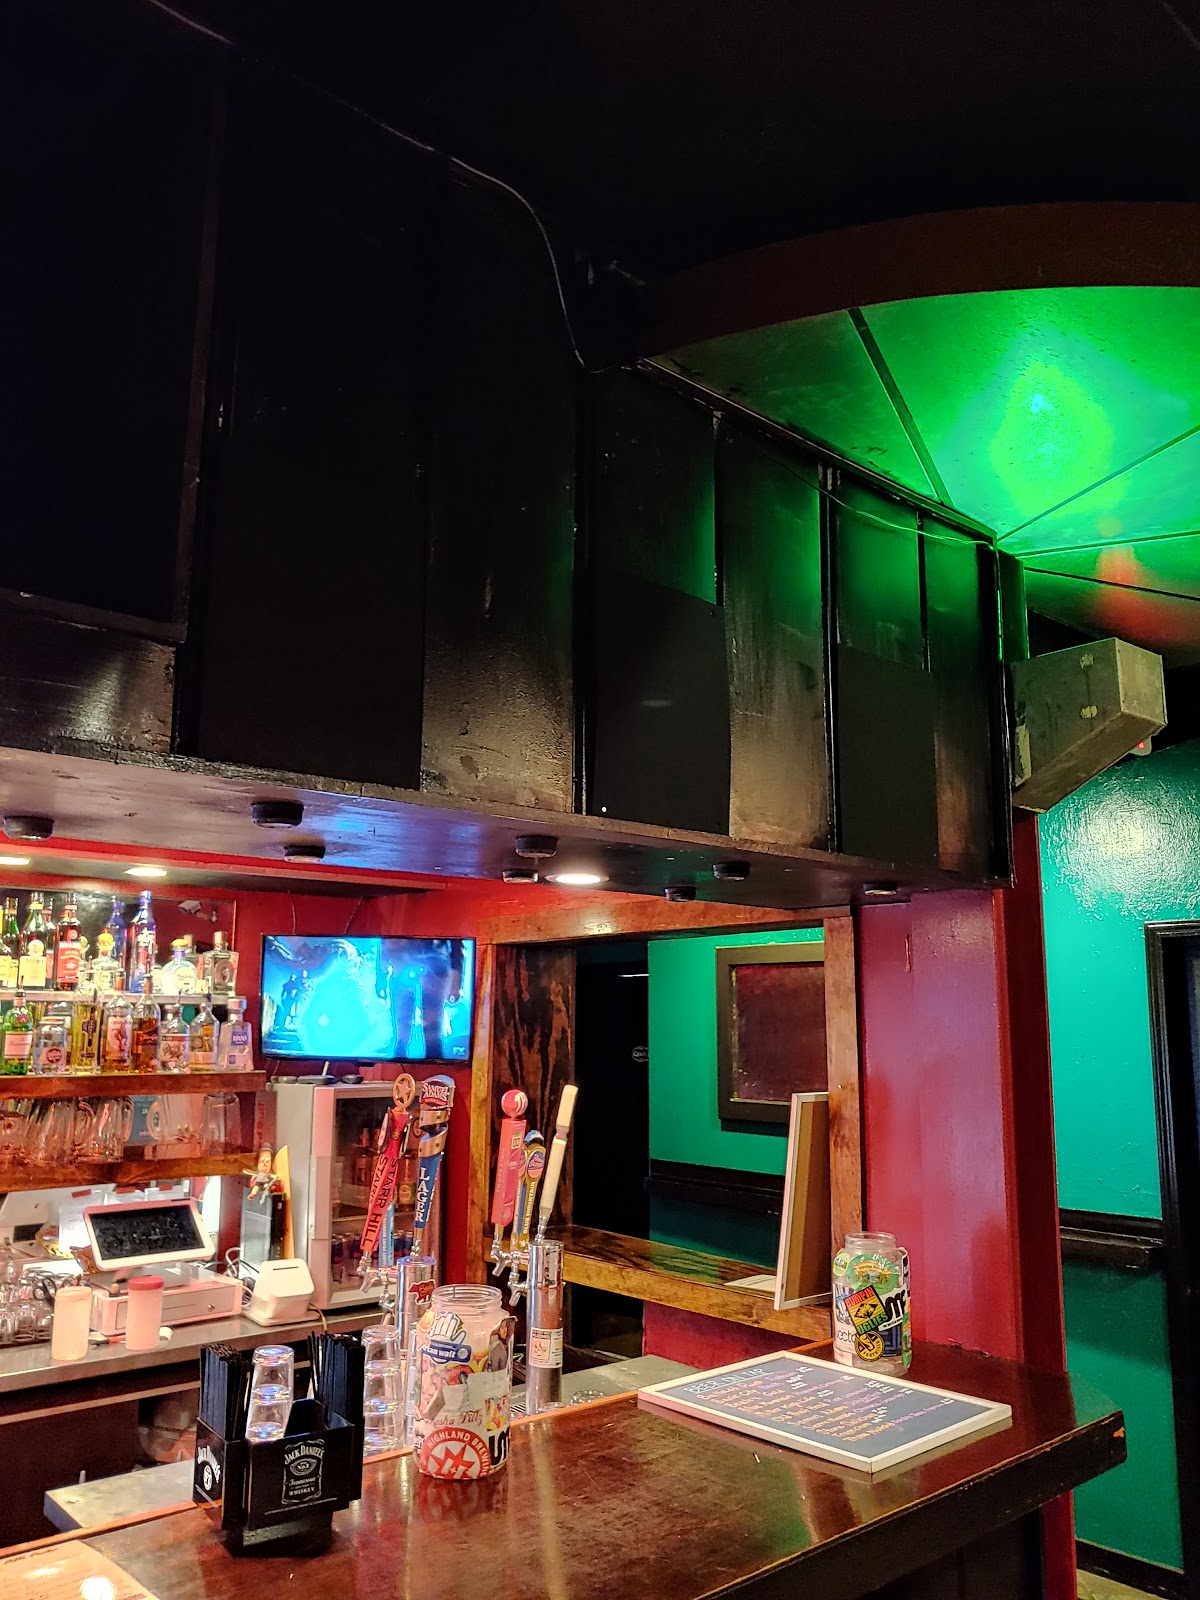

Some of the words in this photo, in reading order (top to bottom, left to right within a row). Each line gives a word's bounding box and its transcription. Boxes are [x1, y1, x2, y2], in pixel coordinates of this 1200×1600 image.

[422, 1083, 450, 1095] SAMUEL
[423, 1090, 448, 1100] ADAMS
[377, 1158, 398, 1209] STARR
[414, 1167, 430, 1223] LAGER
[526, 1181, 536, 1217] MOUNTAIN
[360, 1212, 383, 1250] HILL
[857, 1312, 889, 1335] UGLIES
[427, 1430, 470, 1448] HIGHLAND
[284, 1449, 300, 1464] JACK
[289, 1486, 315, 1496] WHISKEY
